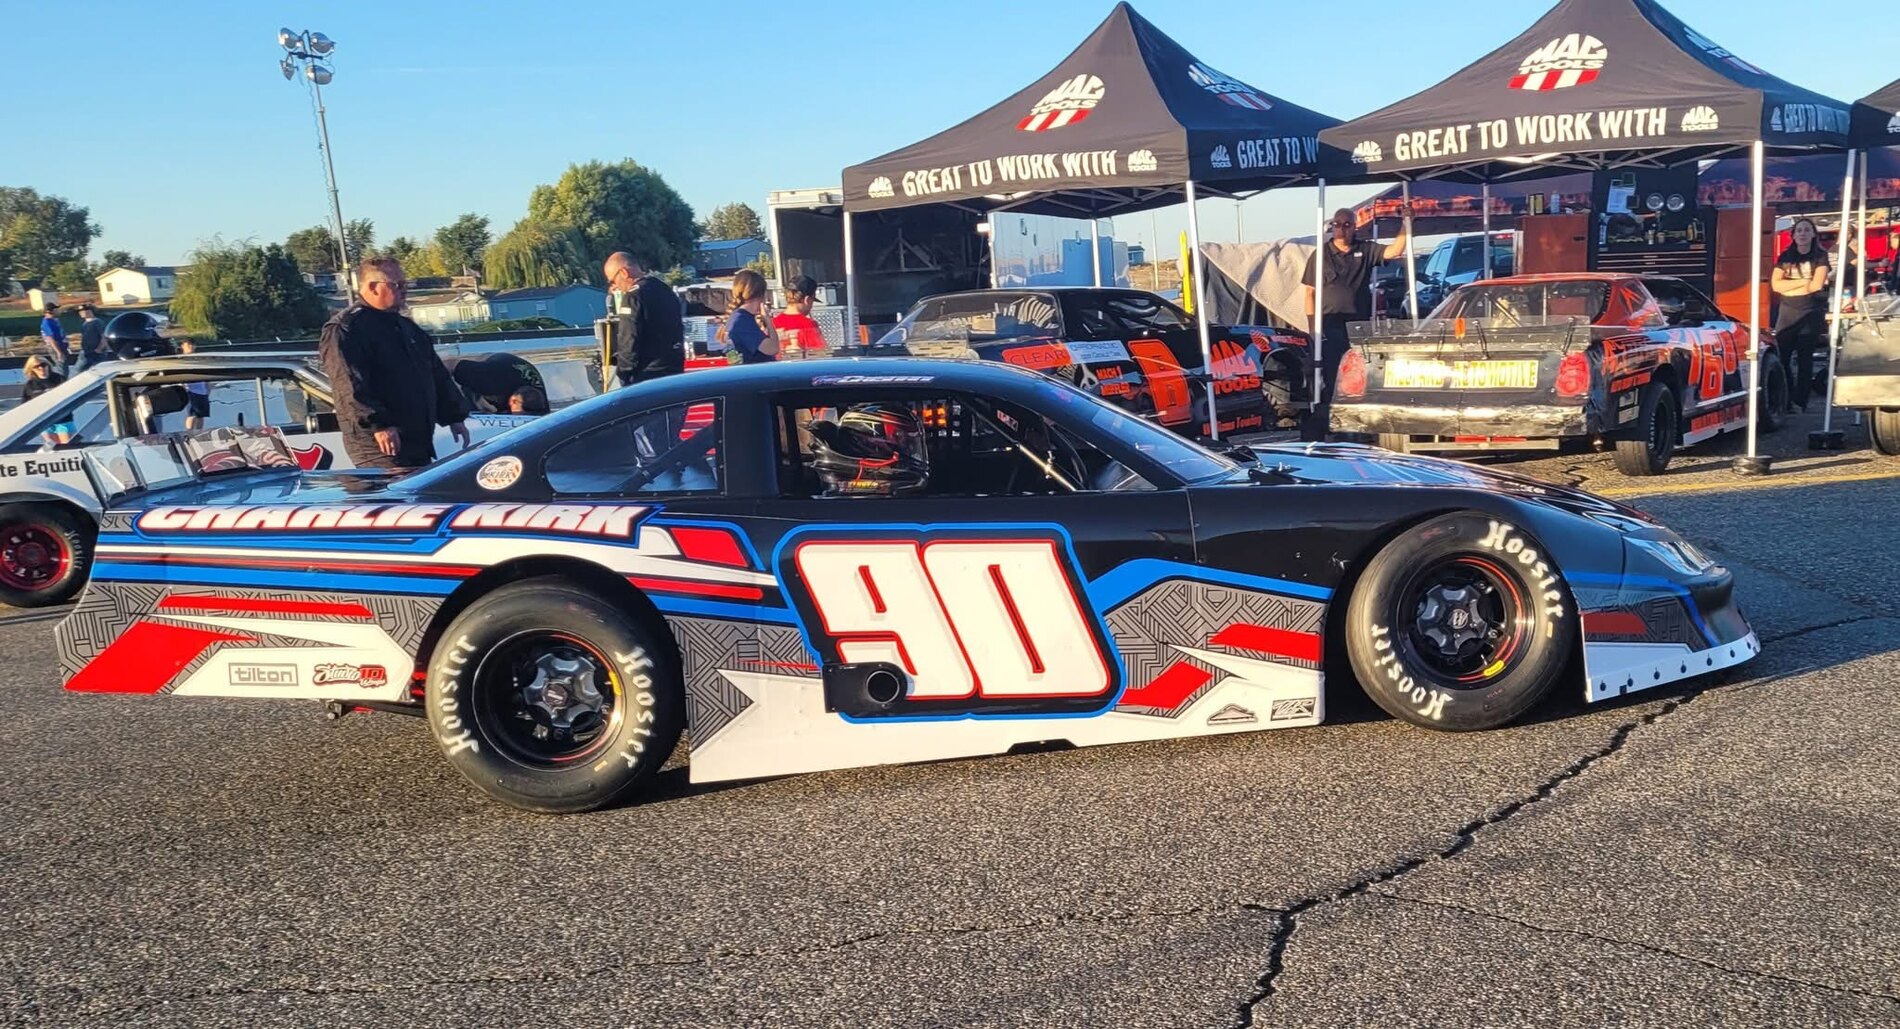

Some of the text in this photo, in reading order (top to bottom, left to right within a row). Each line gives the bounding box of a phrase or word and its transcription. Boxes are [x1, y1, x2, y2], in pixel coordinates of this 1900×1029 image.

[1521, 33, 1608, 67] MAC
[1518, 59, 1604, 74] TOOLS
[1035, 74, 1105, 107] MAC
[1030, 99, 1098, 116] TOOLS
[1681, 105, 1719, 125] MAC
[1394, 107, 1667, 161] GREAT TO WORK WITH
[1680, 121, 1719, 132] TOOLS
[1128, 149, 1157, 165] MAC
[1237, 138, 1280, 169] GREAT
[1282, 137, 1301, 165] TO
[1352, 140, 1382, 157] MAC
[1128, 162, 1157, 172] TOOLS
[1351, 154, 1383, 164] TOOLS
[901, 150, 1118, 198] GREAT TO WORK WITH
[867, 188, 895, 198] TOOLS
[1010, 349, 1067, 365] CLEAR
[1209, 340, 1257, 378] MAC
[1212, 373, 1261, 395] TOOLS
[0, 456, 82, 477] te Equiti
[138, 502, 649, 538] CHARLIE KIRK
[794, 538, 1112, 700] 90
[235, 667, 293, 682] tilton
